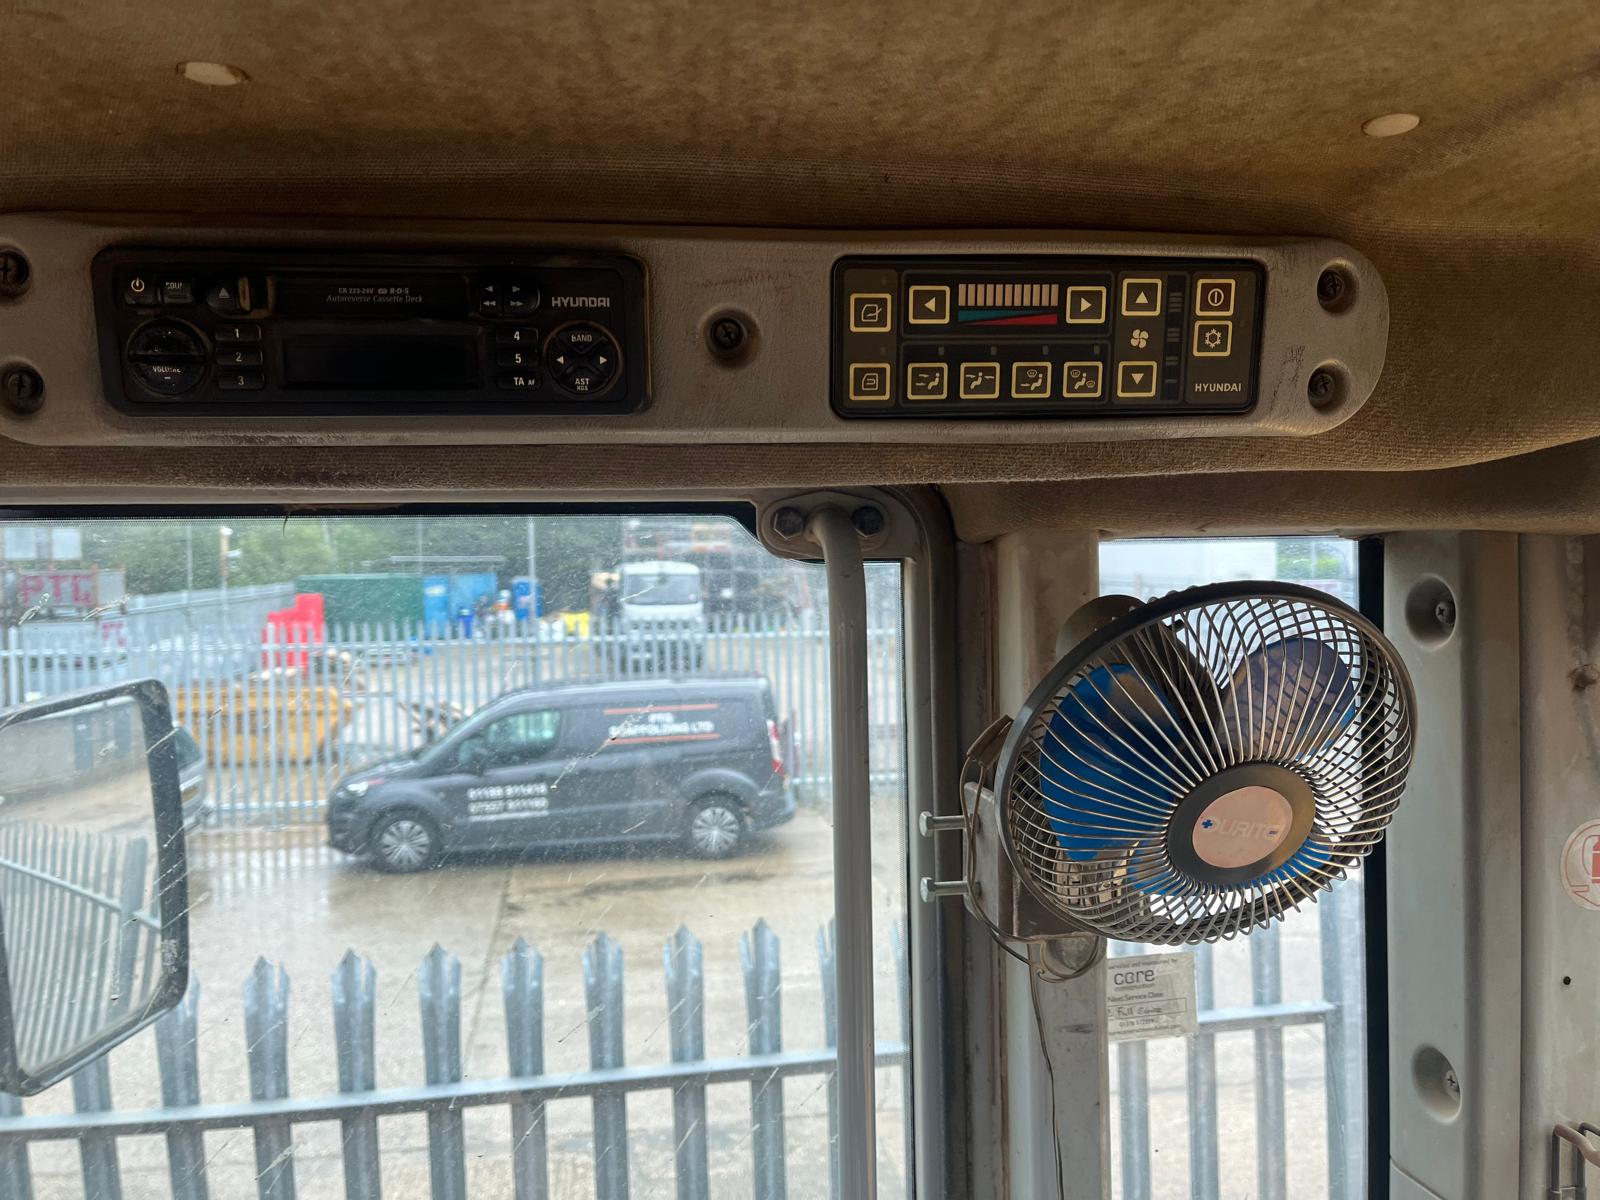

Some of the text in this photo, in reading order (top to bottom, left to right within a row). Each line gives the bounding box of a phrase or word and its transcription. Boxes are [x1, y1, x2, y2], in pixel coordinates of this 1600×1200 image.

[372, 294, 404, 302] Cassette
[405, 294, 424, 303] Deck
[551, 296, 610, 308] HYUNDAI
[234, 328, 240, 338] 1
[513, 330, 520, 341] 4
[571, 333, 592, 343] BAND
[235, 352, 242, 362] 2
[515, 353, 522, 364] 5
[238, 375, 244, 386] 3
[513, 376, 525, 386] TA
[575, 377, 590, 386] AST
[1194, 383, 1242, 392] HYUNDAI
